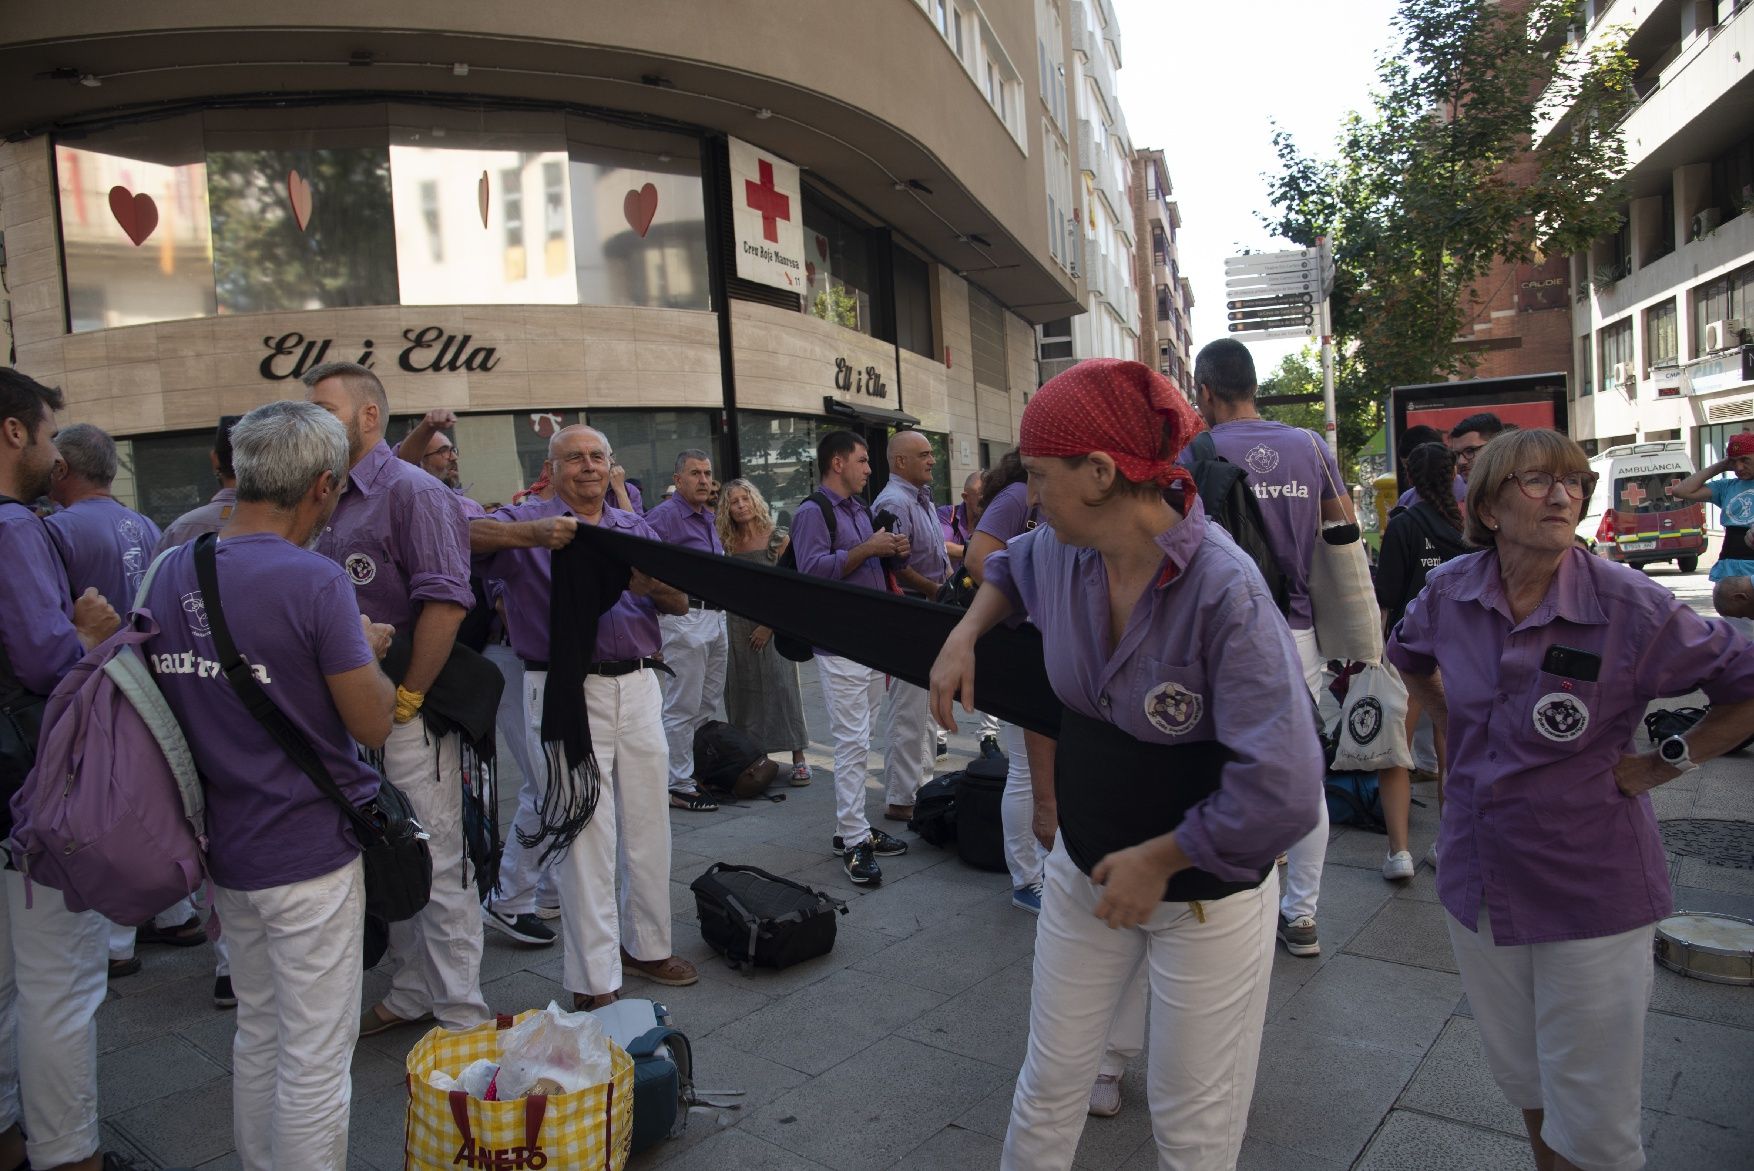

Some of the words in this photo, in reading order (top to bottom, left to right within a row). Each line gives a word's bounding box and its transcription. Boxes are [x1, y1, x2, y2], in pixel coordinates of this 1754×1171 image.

[743, 241, 759, 256] Creu
[760, 246, 773, 263] Roja
[774, 251, 800, 270] Manresa
[259, 332, 333, 380] Ell
[398, 326, 501, 372] Ella
[835, 357, 853, 392] Ell
[856, 370, 863, 394] i
[865, 366, 888, 399] Ella
